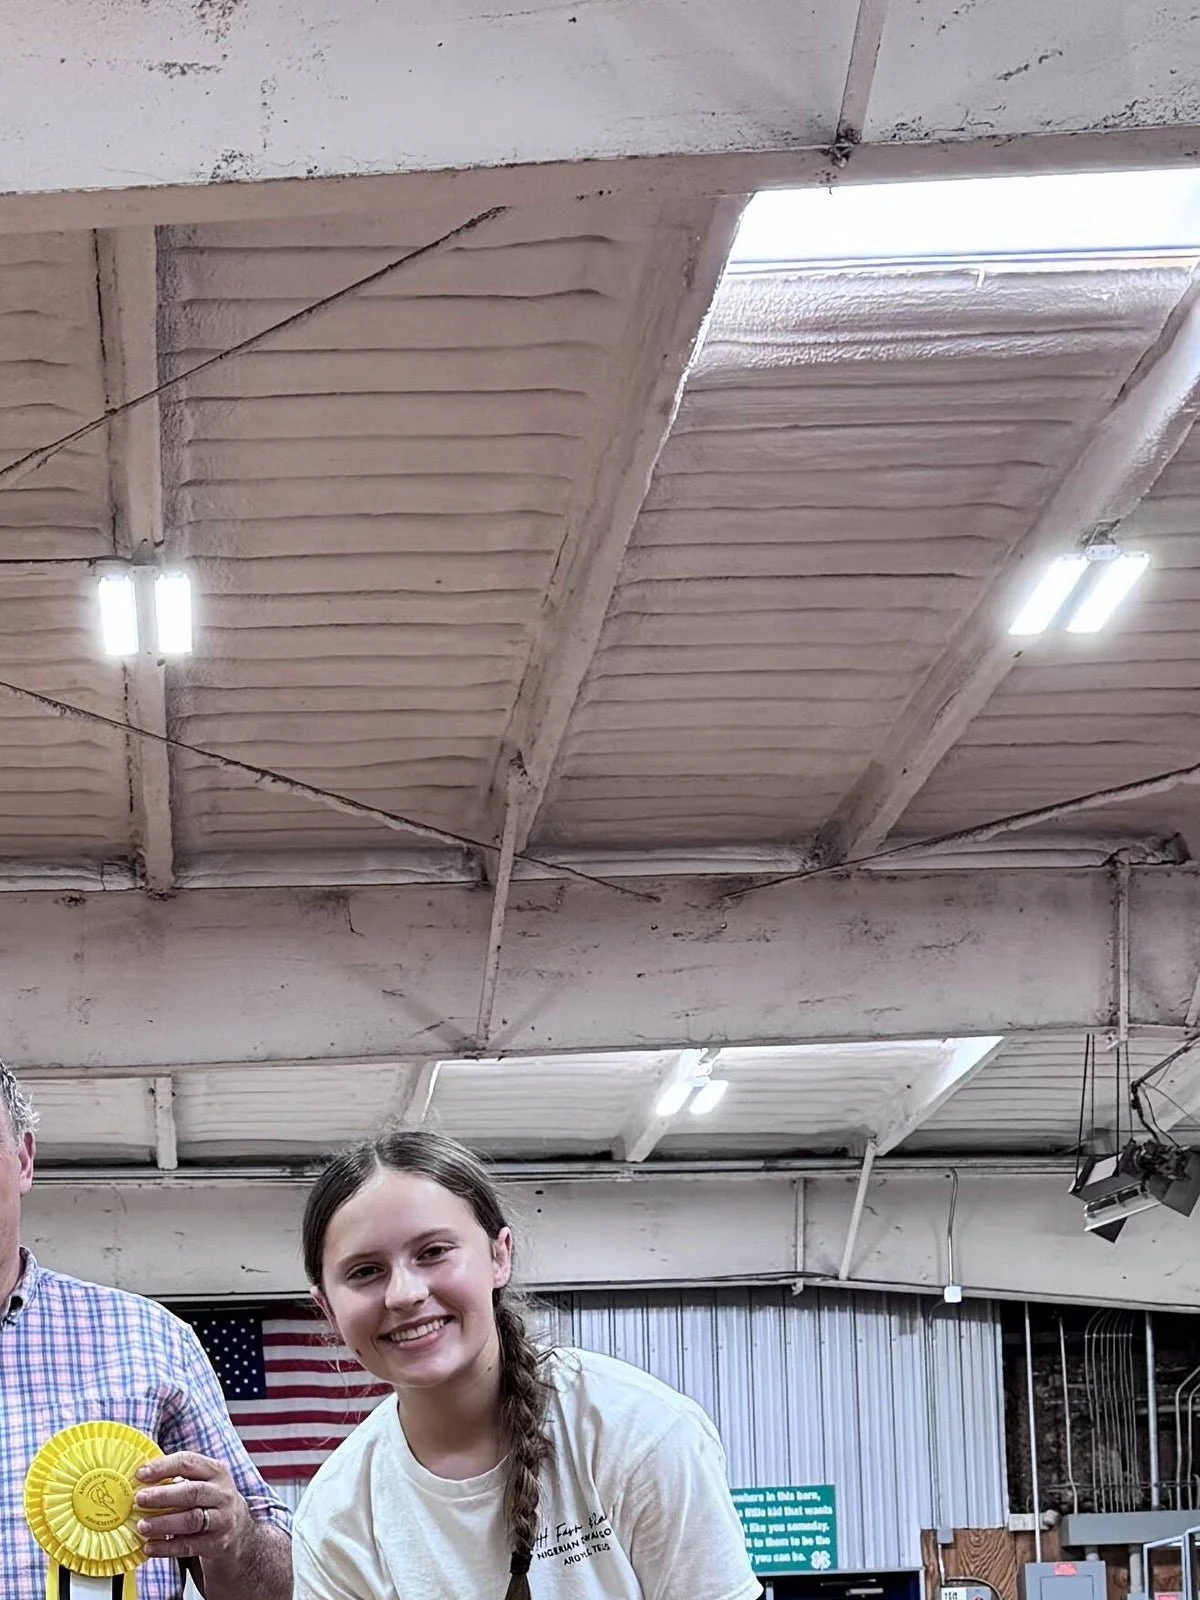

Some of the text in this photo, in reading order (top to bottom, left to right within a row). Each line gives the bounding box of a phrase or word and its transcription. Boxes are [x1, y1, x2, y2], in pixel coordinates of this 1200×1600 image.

[776, 1491, 795, 1501] this
[767, 1506, 782, 1516] kid
[784, 1505, 803, 1516] that
[768, 1523, 785, 1534] you
[815, 1535, 831, 1545] the
[537, 1540, 580, 1560] NIGERIAN
[754, 1554, 772, 1565] you
